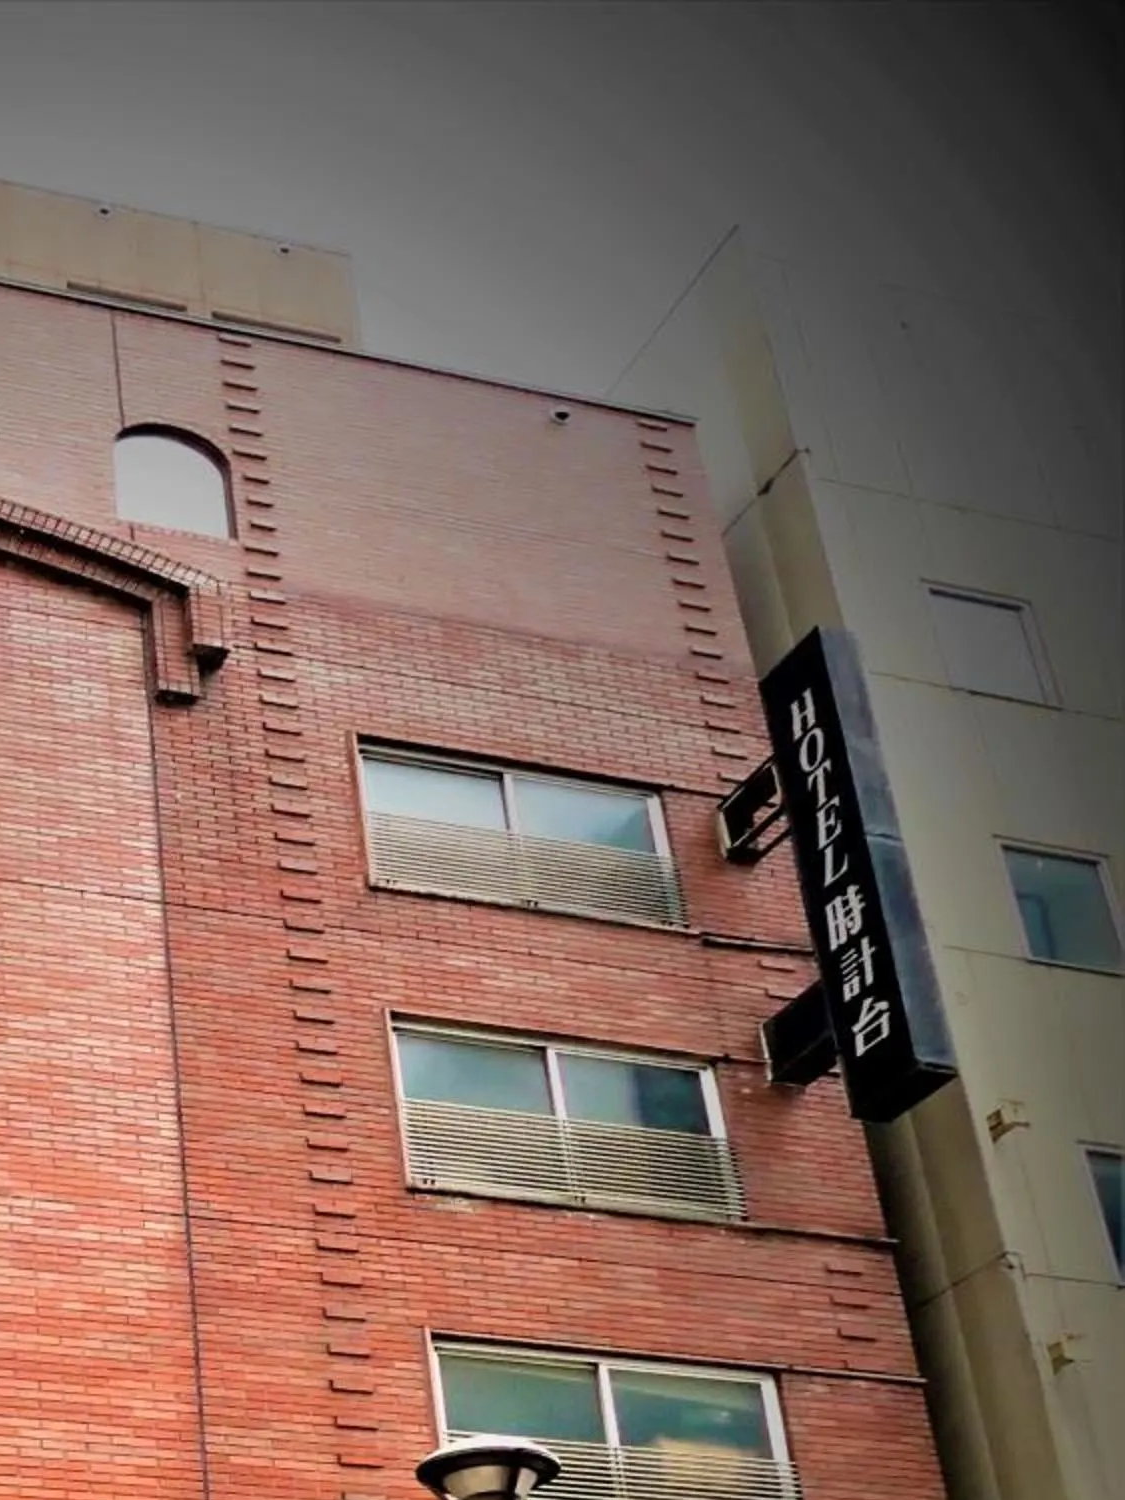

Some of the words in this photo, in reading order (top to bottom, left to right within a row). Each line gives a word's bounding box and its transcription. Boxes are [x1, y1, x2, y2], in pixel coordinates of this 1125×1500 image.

[791, 688, 849, 889] HOTEL
[826, 884, 890, 1057] 時計台
